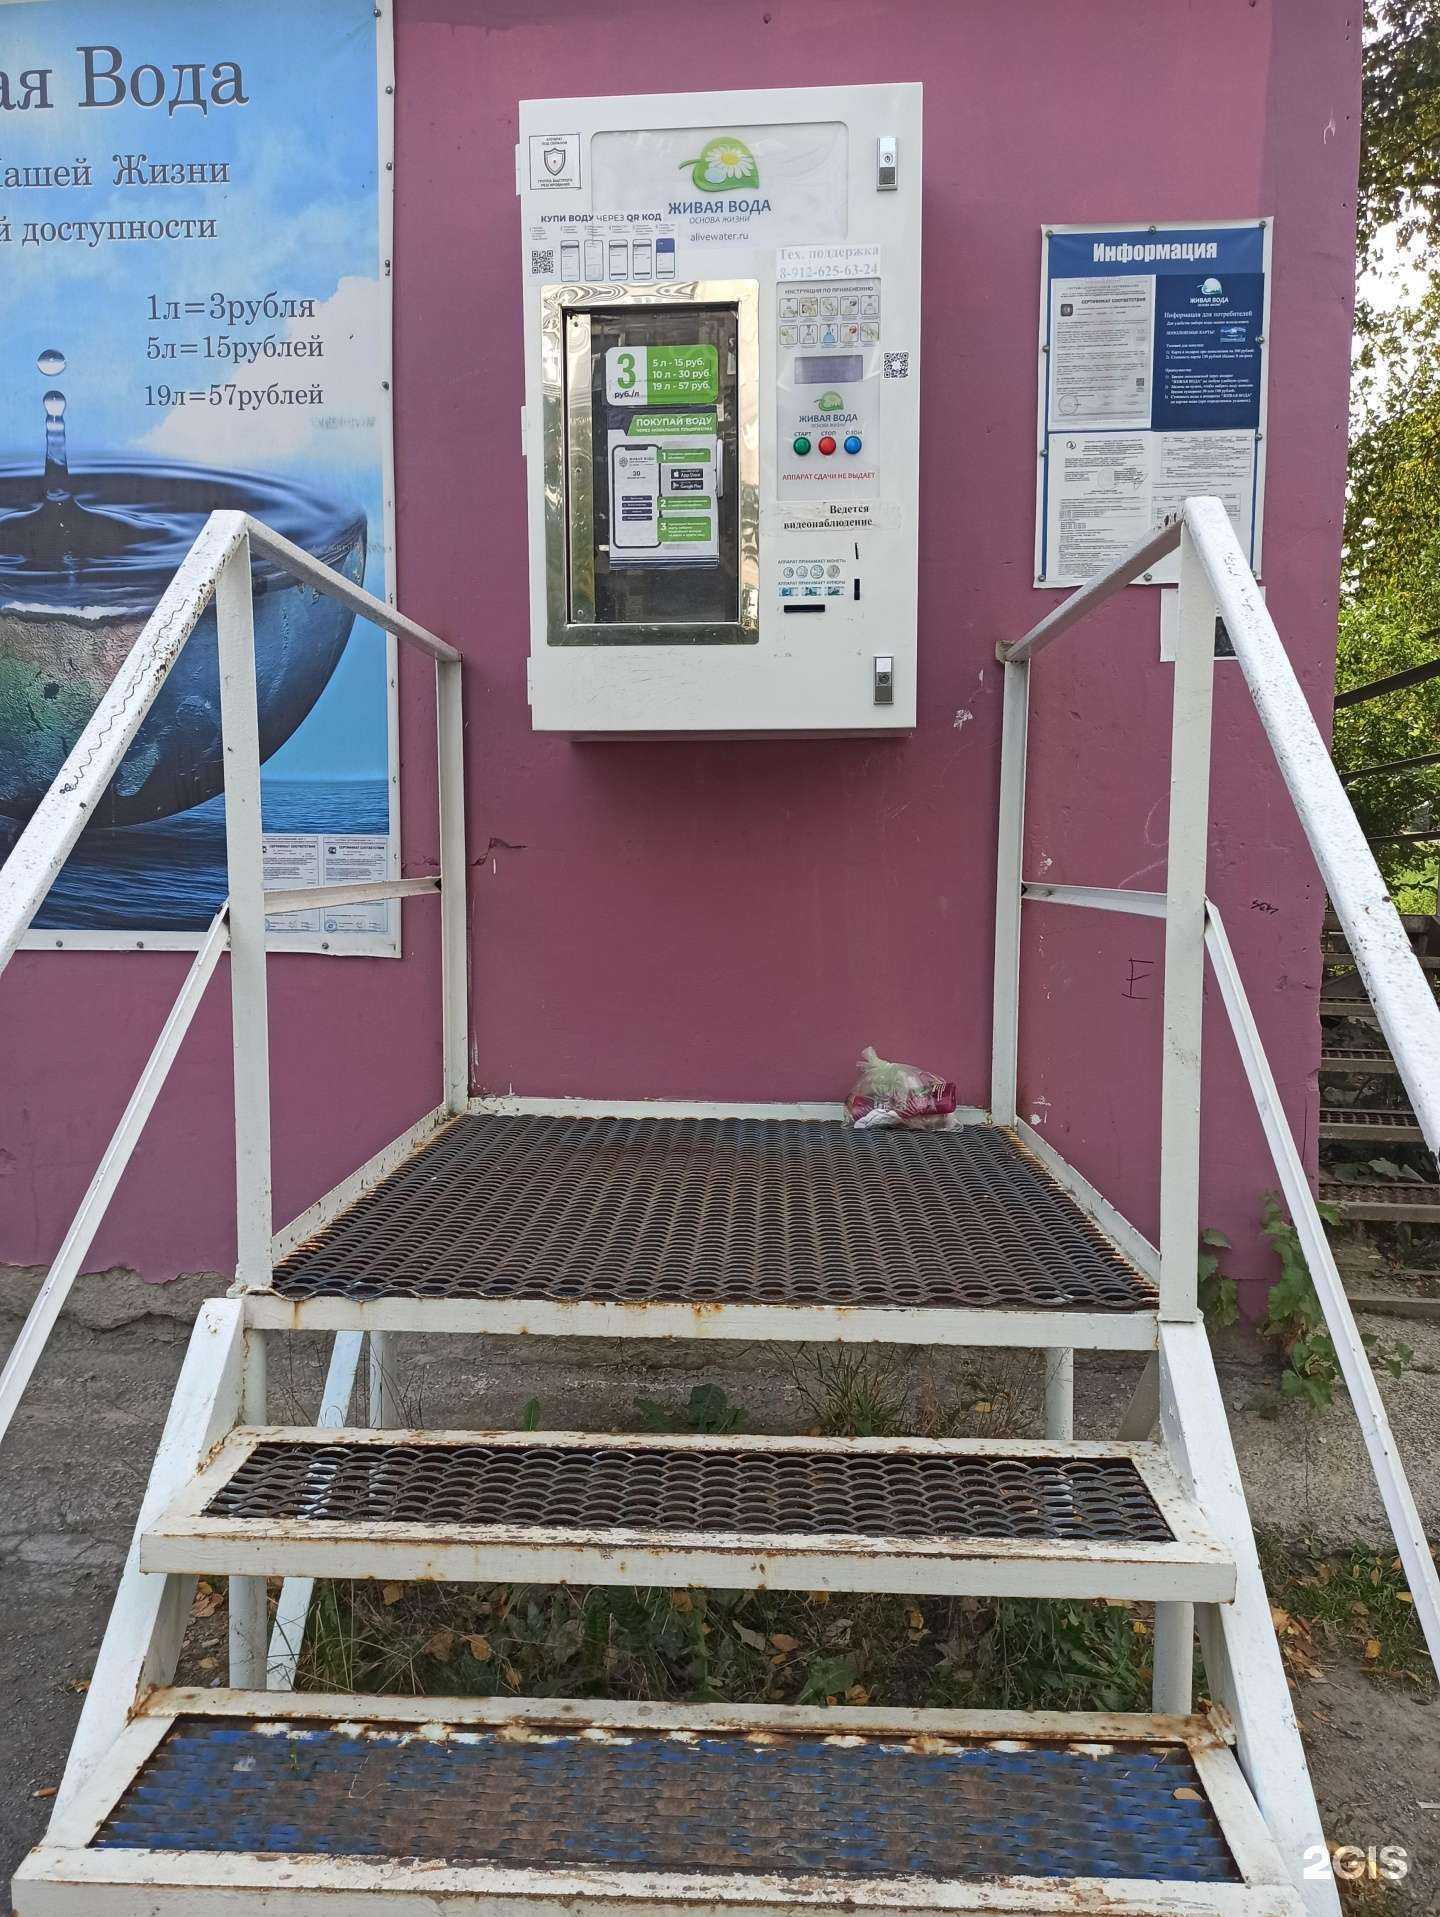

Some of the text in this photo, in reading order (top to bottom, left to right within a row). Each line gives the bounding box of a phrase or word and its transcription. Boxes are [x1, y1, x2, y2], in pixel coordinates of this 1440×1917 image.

[76, 45, 250, 117] Вода
[0, 153, 231, 188] ашей Жизни
[668, 199, 772, 215] ЖИВАЯ ВОДА
[540, 212, 662, 223] КУПИ ВОДУ ЧЕРЕЗ QR КОД
[689, 215, 751, 225] ОСНОВА ЖИЗНИ
[22, 216, 218, 248] доступности
[689, 231, 750, 242] alivewater.ru
[780, 247, 879, 260] Тех. поддержка
[1093, 242, 1218, 263] Информация
[779, 263, 878, 279] 8-912-625-63-24
[146, 292, 316, 326] 1л=3рубля
[145, 334, 325, 364] 5л=15рублей
[652, 359, 658, 367] 5
[674, 359, 683, 367] 15
[685, 358, 705, 369] руб.
[617, 353, 636, 389] 3
[652, 370, 663, 379] 10
[664, 371, 671, 379] л
[678, 369, 691, 378] 30
[692, 368, 712, 379] руб.
[652, 382, 663, 390] 19
[678, 381, 689, 390] 57
[691, 380, 711, 391] руб.
[144, 383, 324, 411] 19л=57рублей
[614, 389, 640, 399] руб./л
[636, 416, 713, 426] ПОКУПАЙ ВОДУ
[798, 413, 858, 423] ЖИВАЯ ВОДА
[782, 473, 813, 481] АППАРАТ
[848, 471, 875, 480] ВЫДАЕТ
[660, 499, 667, 508] 2
[829, 504, 870, 514] Ведется
[660, 522, 667, 531] 3
[783, 518, 873, 530] видеонаблюдение
